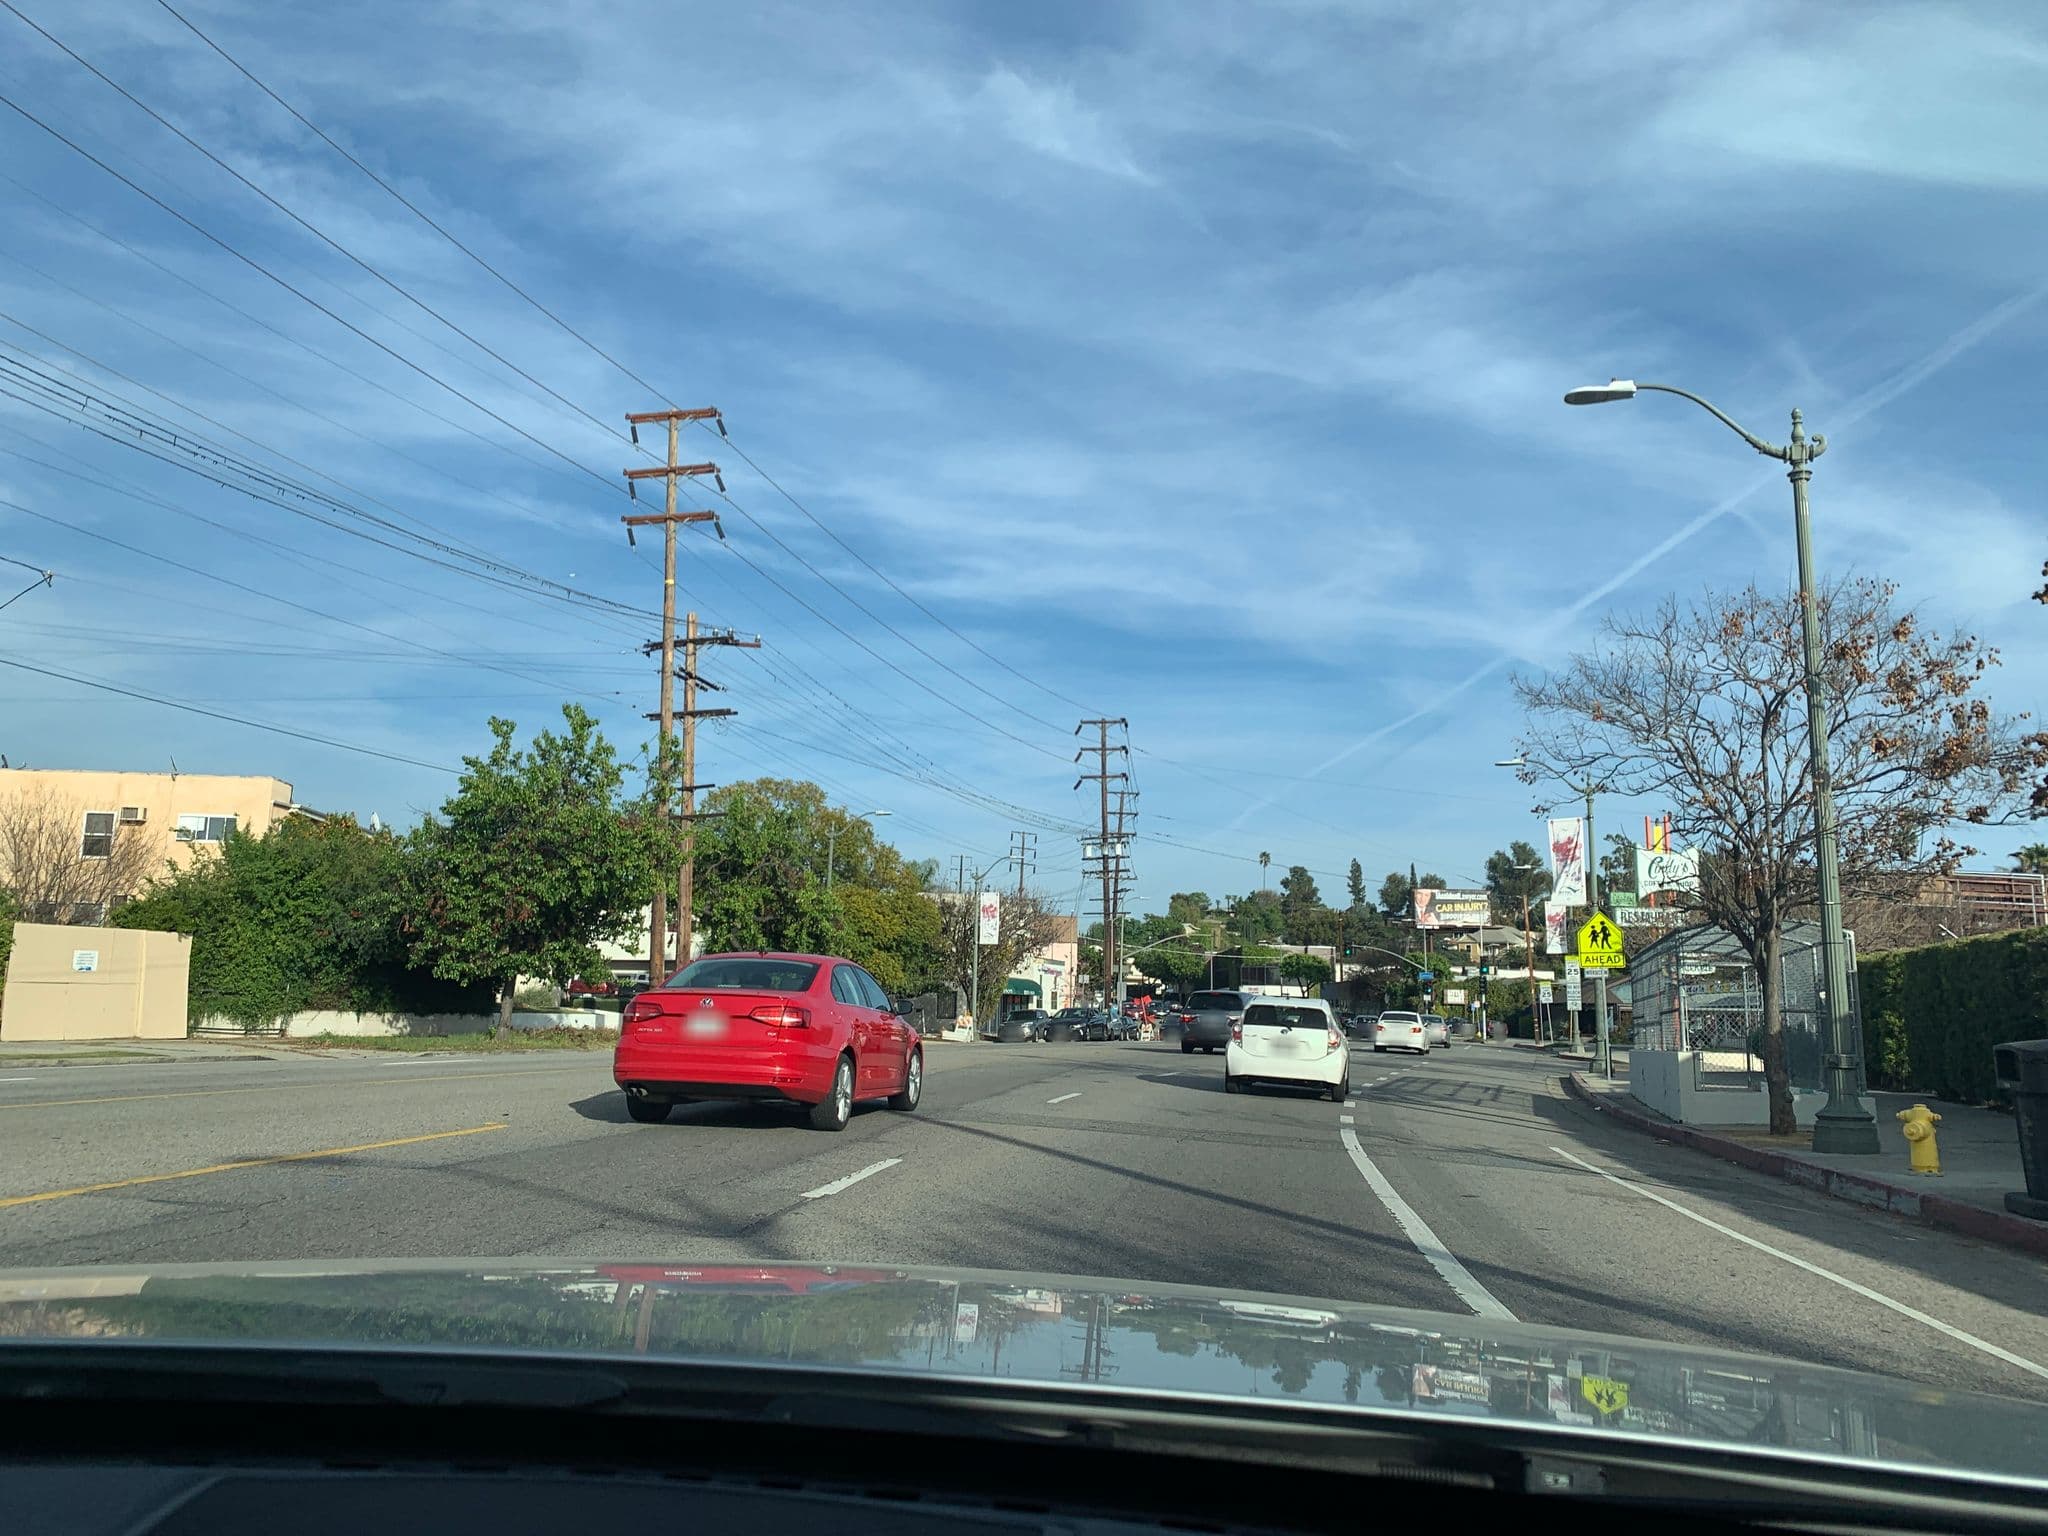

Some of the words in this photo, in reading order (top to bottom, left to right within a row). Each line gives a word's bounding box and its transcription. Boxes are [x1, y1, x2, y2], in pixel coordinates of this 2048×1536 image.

[1435, 903, 1453, 912] CAR
[1584, 955, 1621, 964] AHEAD
[1567, 968, 1579, 976] 25
